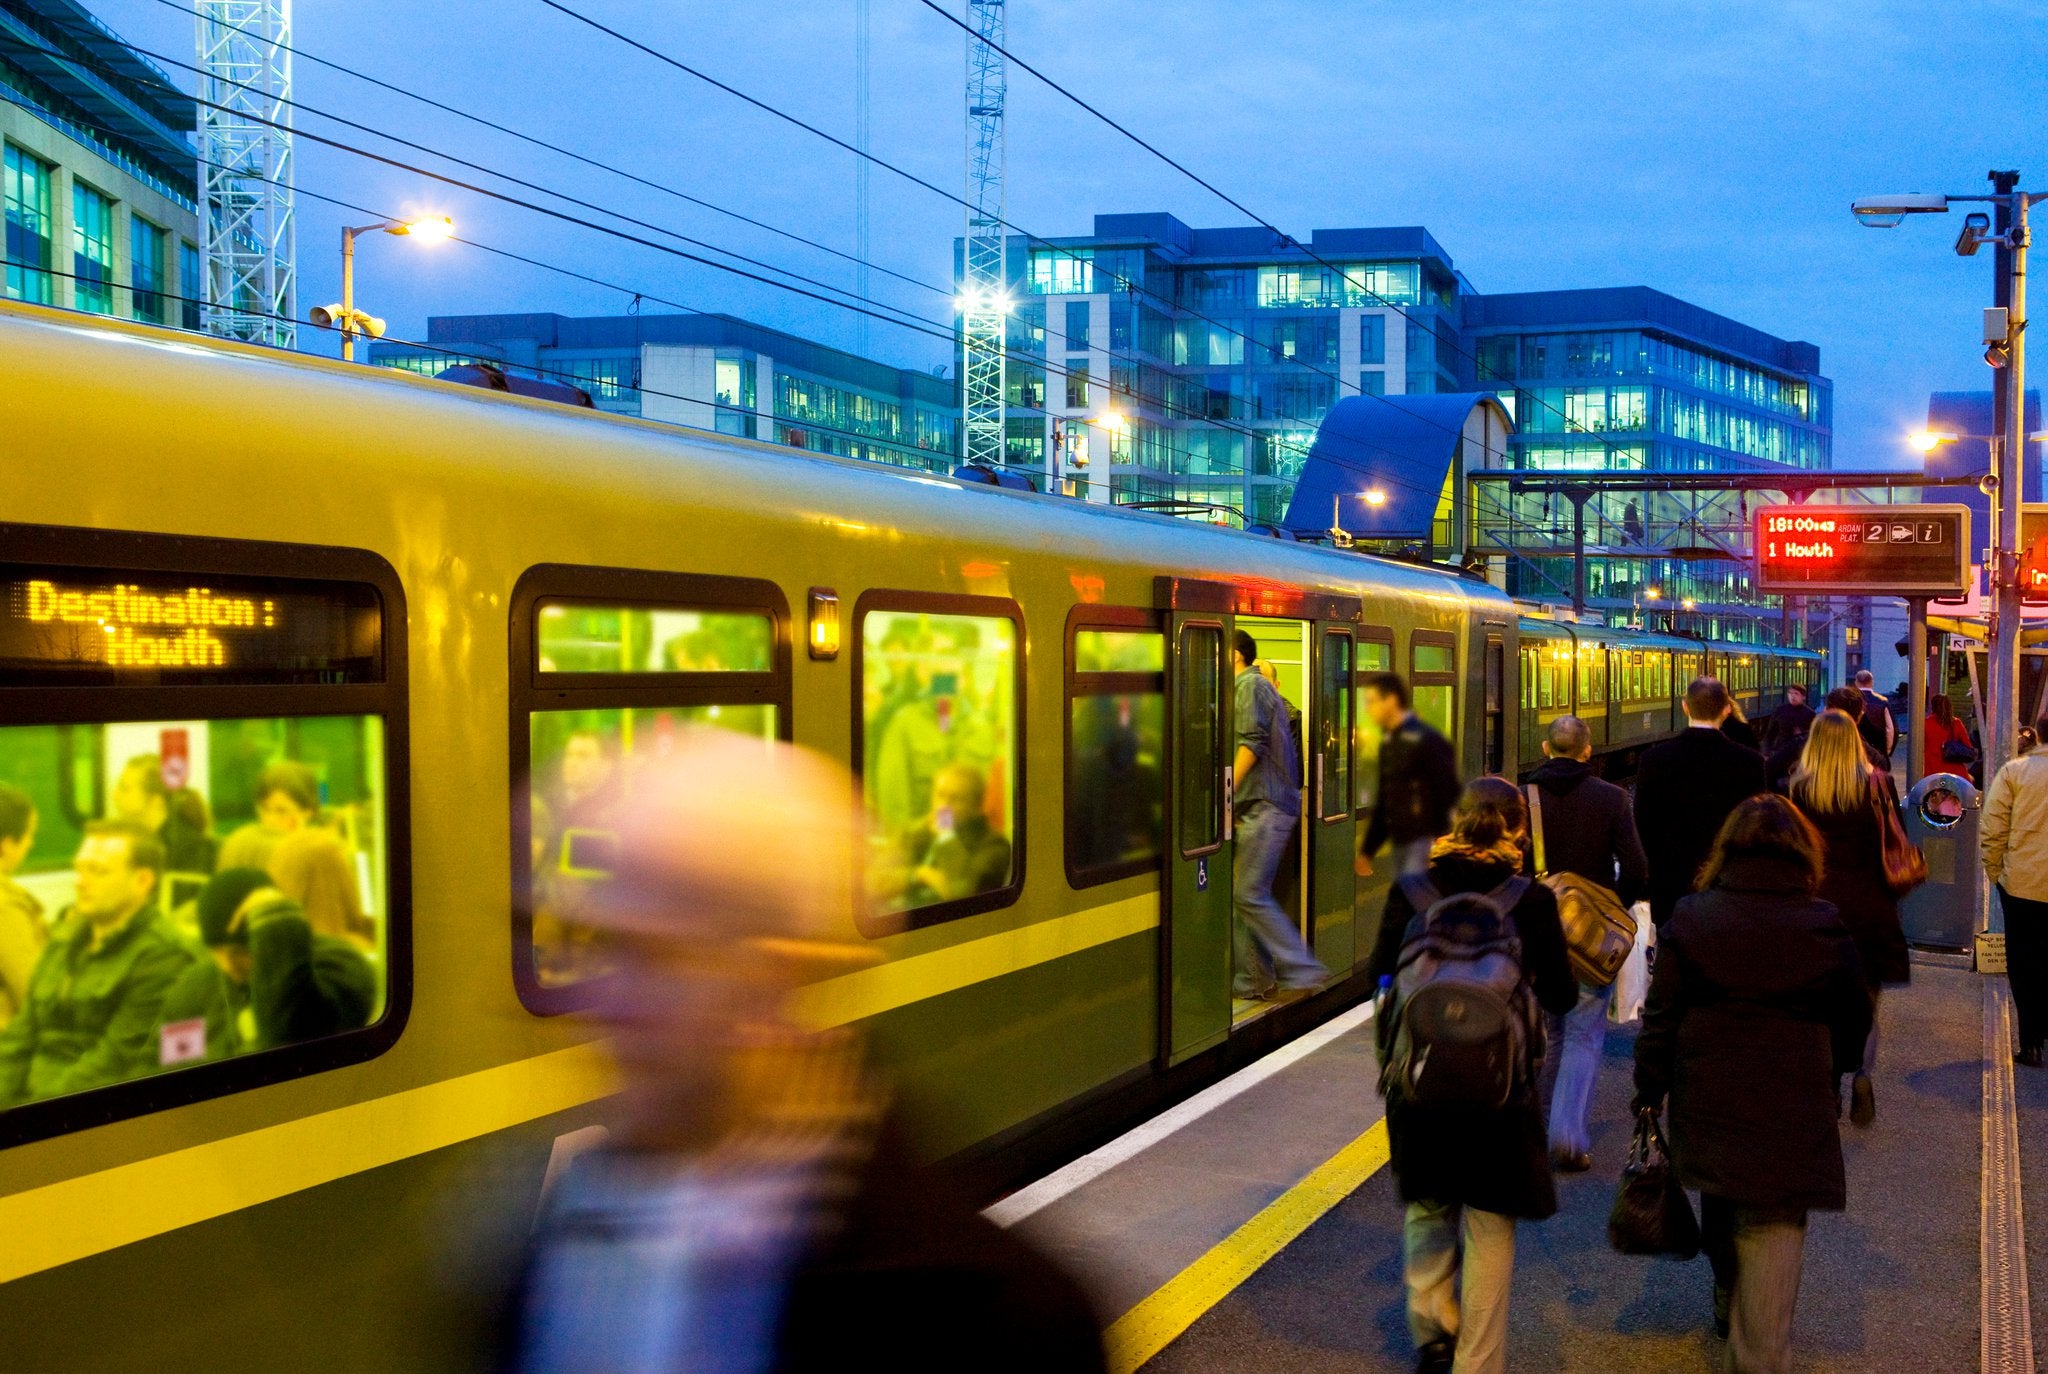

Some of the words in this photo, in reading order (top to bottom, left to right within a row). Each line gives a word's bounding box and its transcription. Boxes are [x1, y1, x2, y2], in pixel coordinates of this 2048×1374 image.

[1867, 525, 1883, 541] 2
[1768, 542, 1777, 557] 1
[1785, 542, 1834, 558] Howth
[28, 580, 254, 627] Destination
[106, 627, 225, 666] Howth
